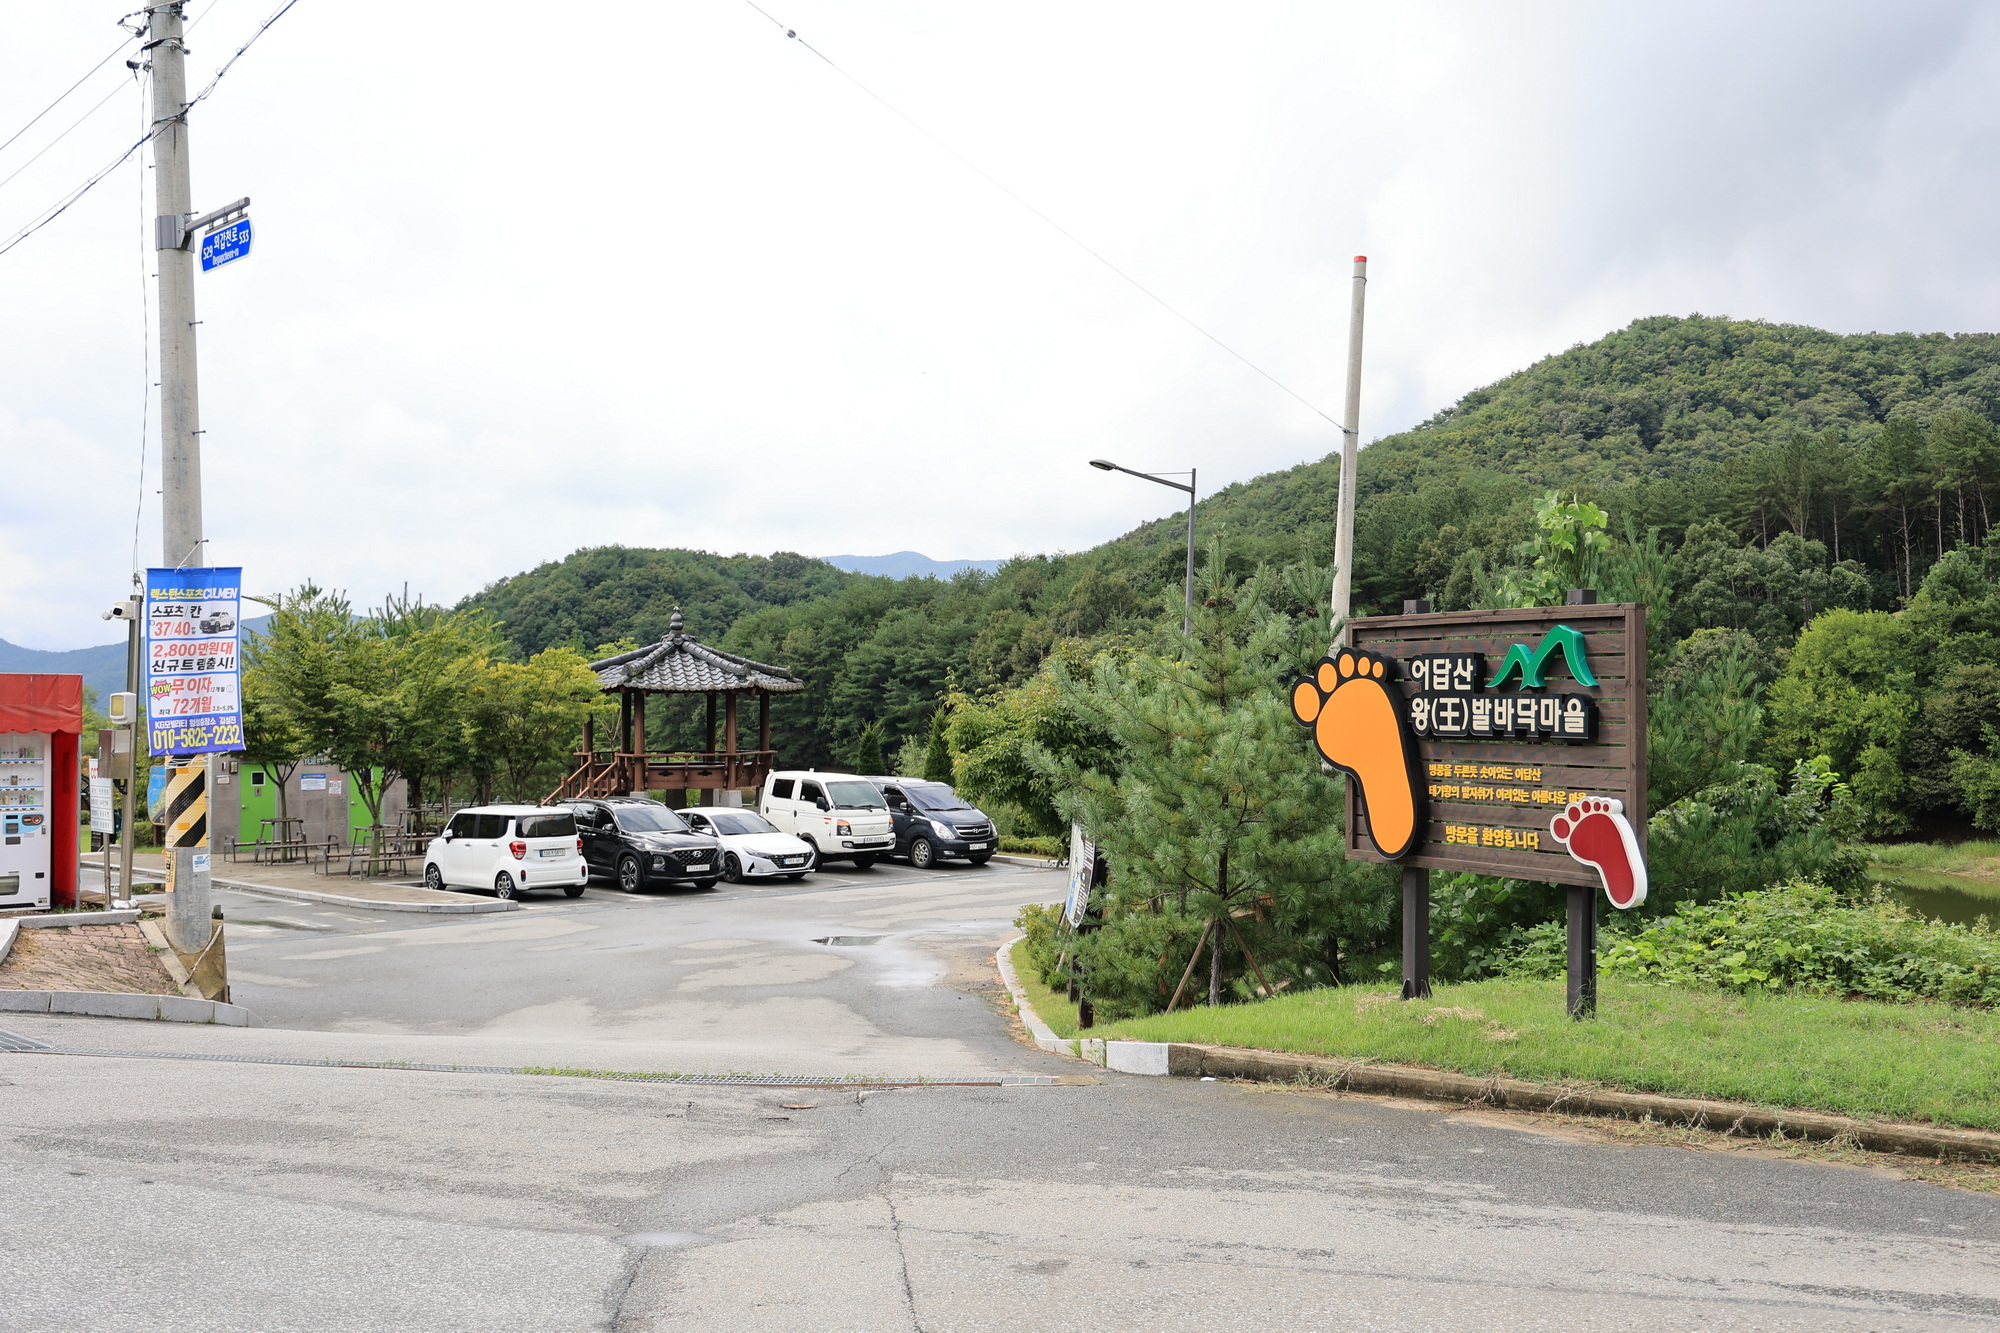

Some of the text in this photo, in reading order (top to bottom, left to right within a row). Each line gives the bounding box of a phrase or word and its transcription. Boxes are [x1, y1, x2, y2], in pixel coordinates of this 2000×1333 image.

[238, 229, 250, 245] 533
[150, 587, 238, 600] 렉스턴스포츠 CULMEN
[153, 641, 234, 658] 2,800만원대
[1411, 658, 1474, 691] 어답산
[150, 683, 171, 695] WOW
[172, 696, 212, 714] 72개월
[154, 719, 188, 729] KG모빌리티
[153, 724, 241, 750] 010-5825-2232
[1428, 764, 1542, 782] 병풍을 두른듯 솟아있는 어답산
[1461, 786, 1494, 800] 발자취가
[1496, 788, 1530, 803] 어려있는
[1531, 790, 1567, 805] 아름다운
[1445, 825, 1479, 845] 방문을
